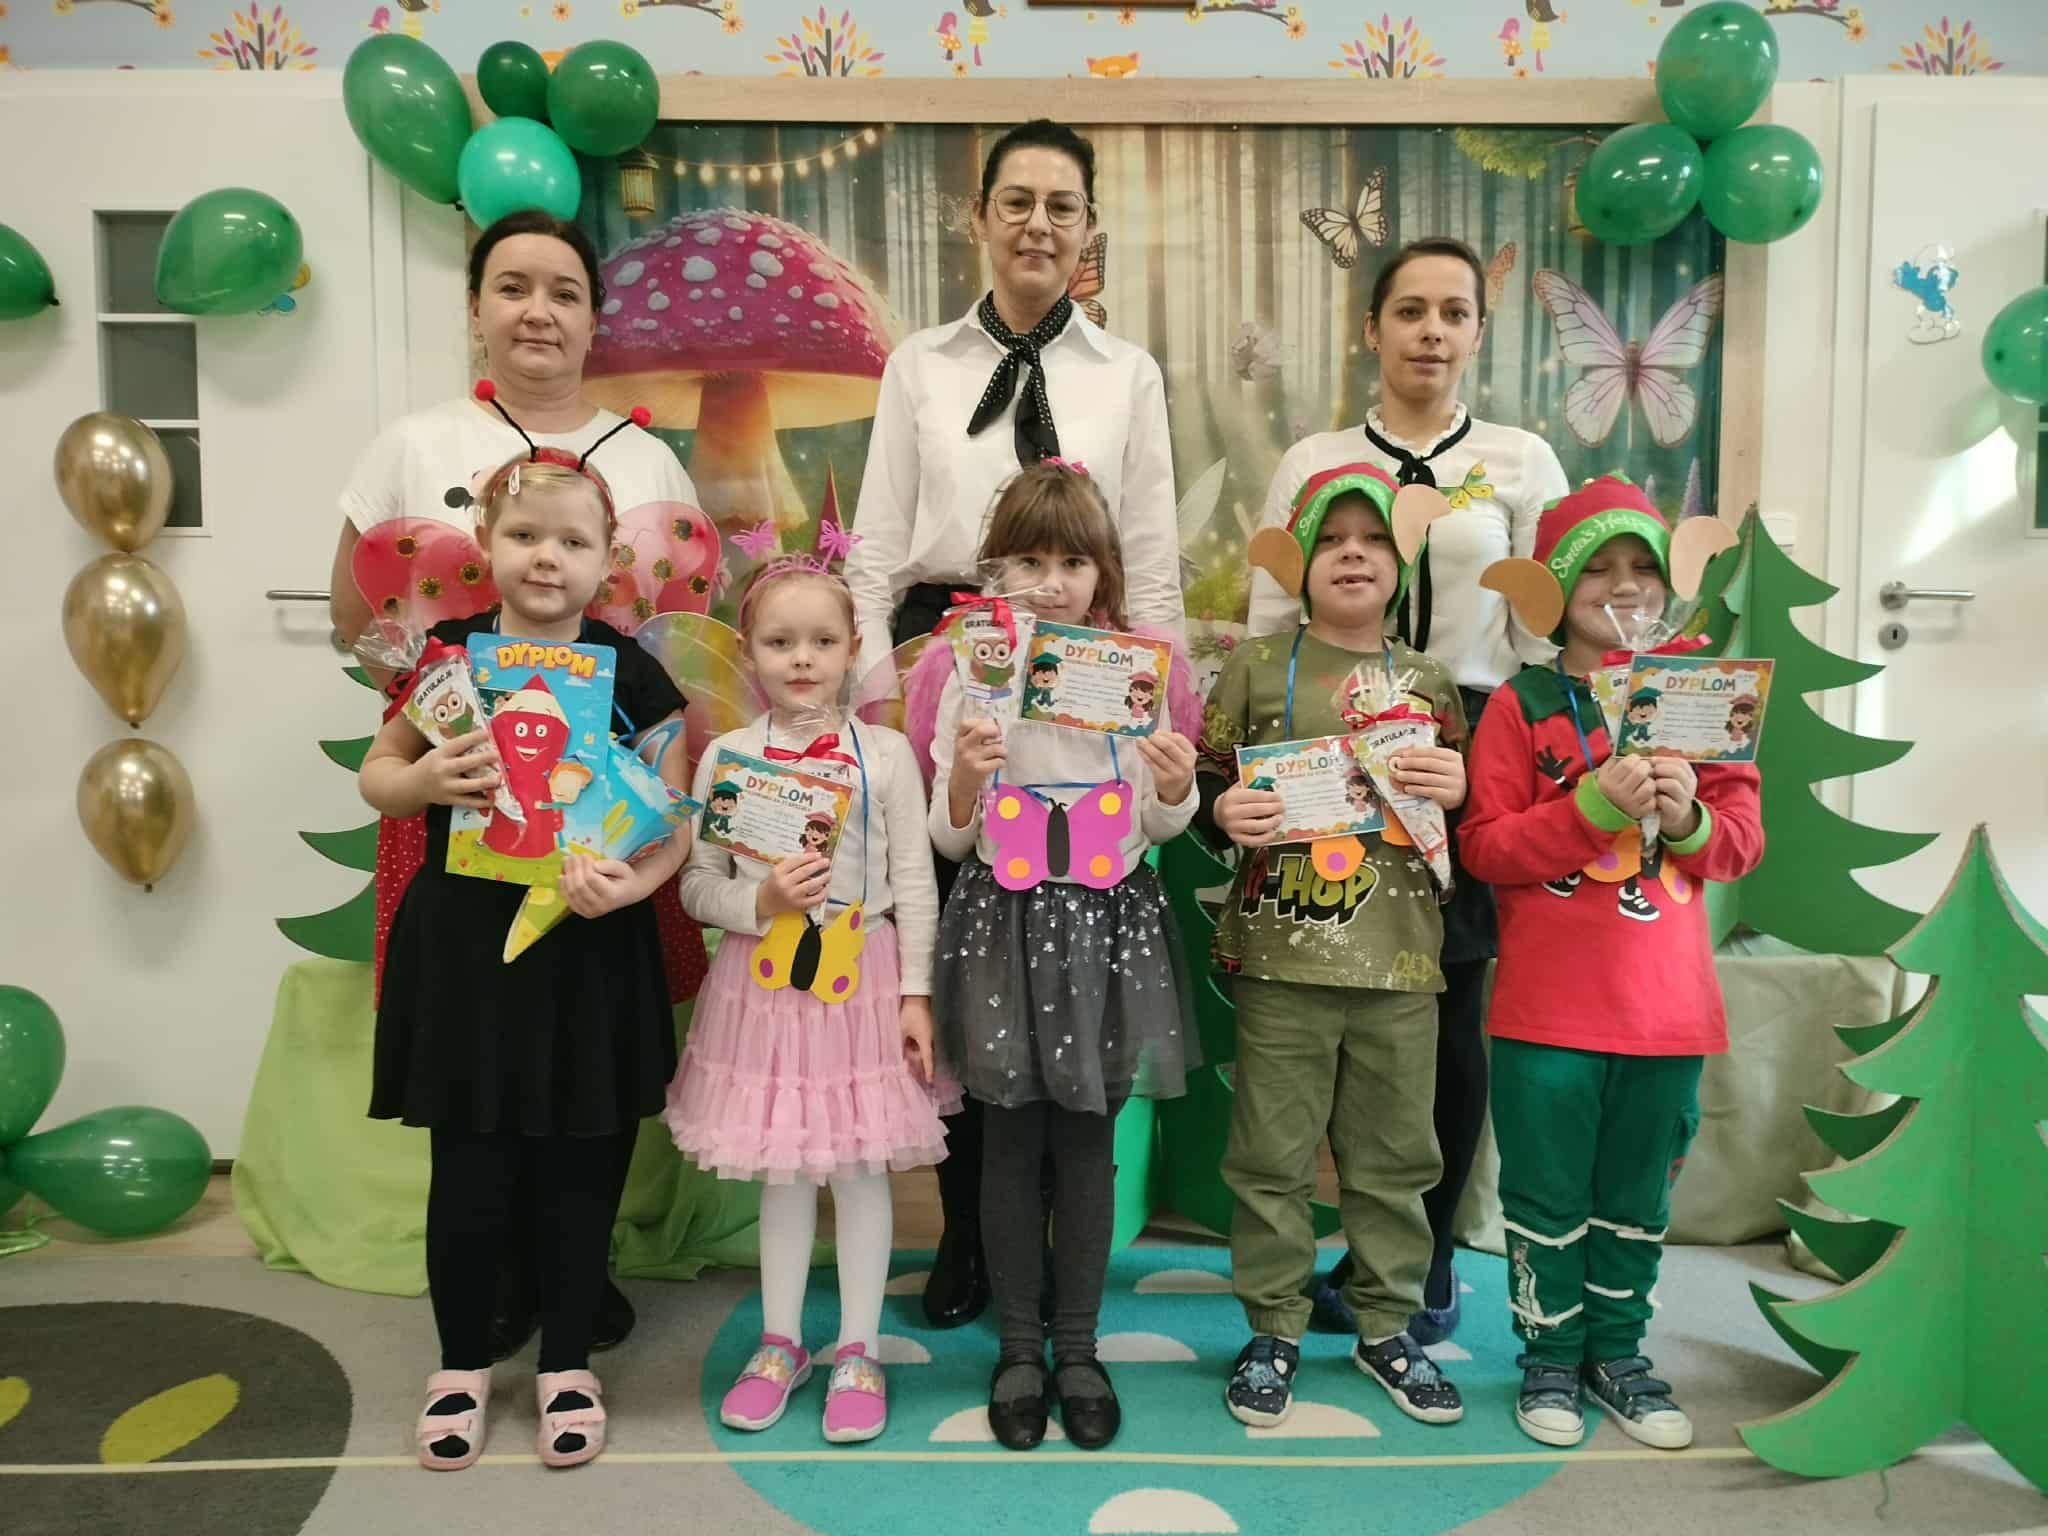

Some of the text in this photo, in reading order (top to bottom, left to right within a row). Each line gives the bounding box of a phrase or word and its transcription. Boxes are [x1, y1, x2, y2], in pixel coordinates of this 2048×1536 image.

[496, 641, 598, 679] DYPLOM
[1065, 644, 1133, 667] DYPLOM
[1665, 676, 1736, 691] DYPLOM
[746, 775, 814, 807] DYPLOM
